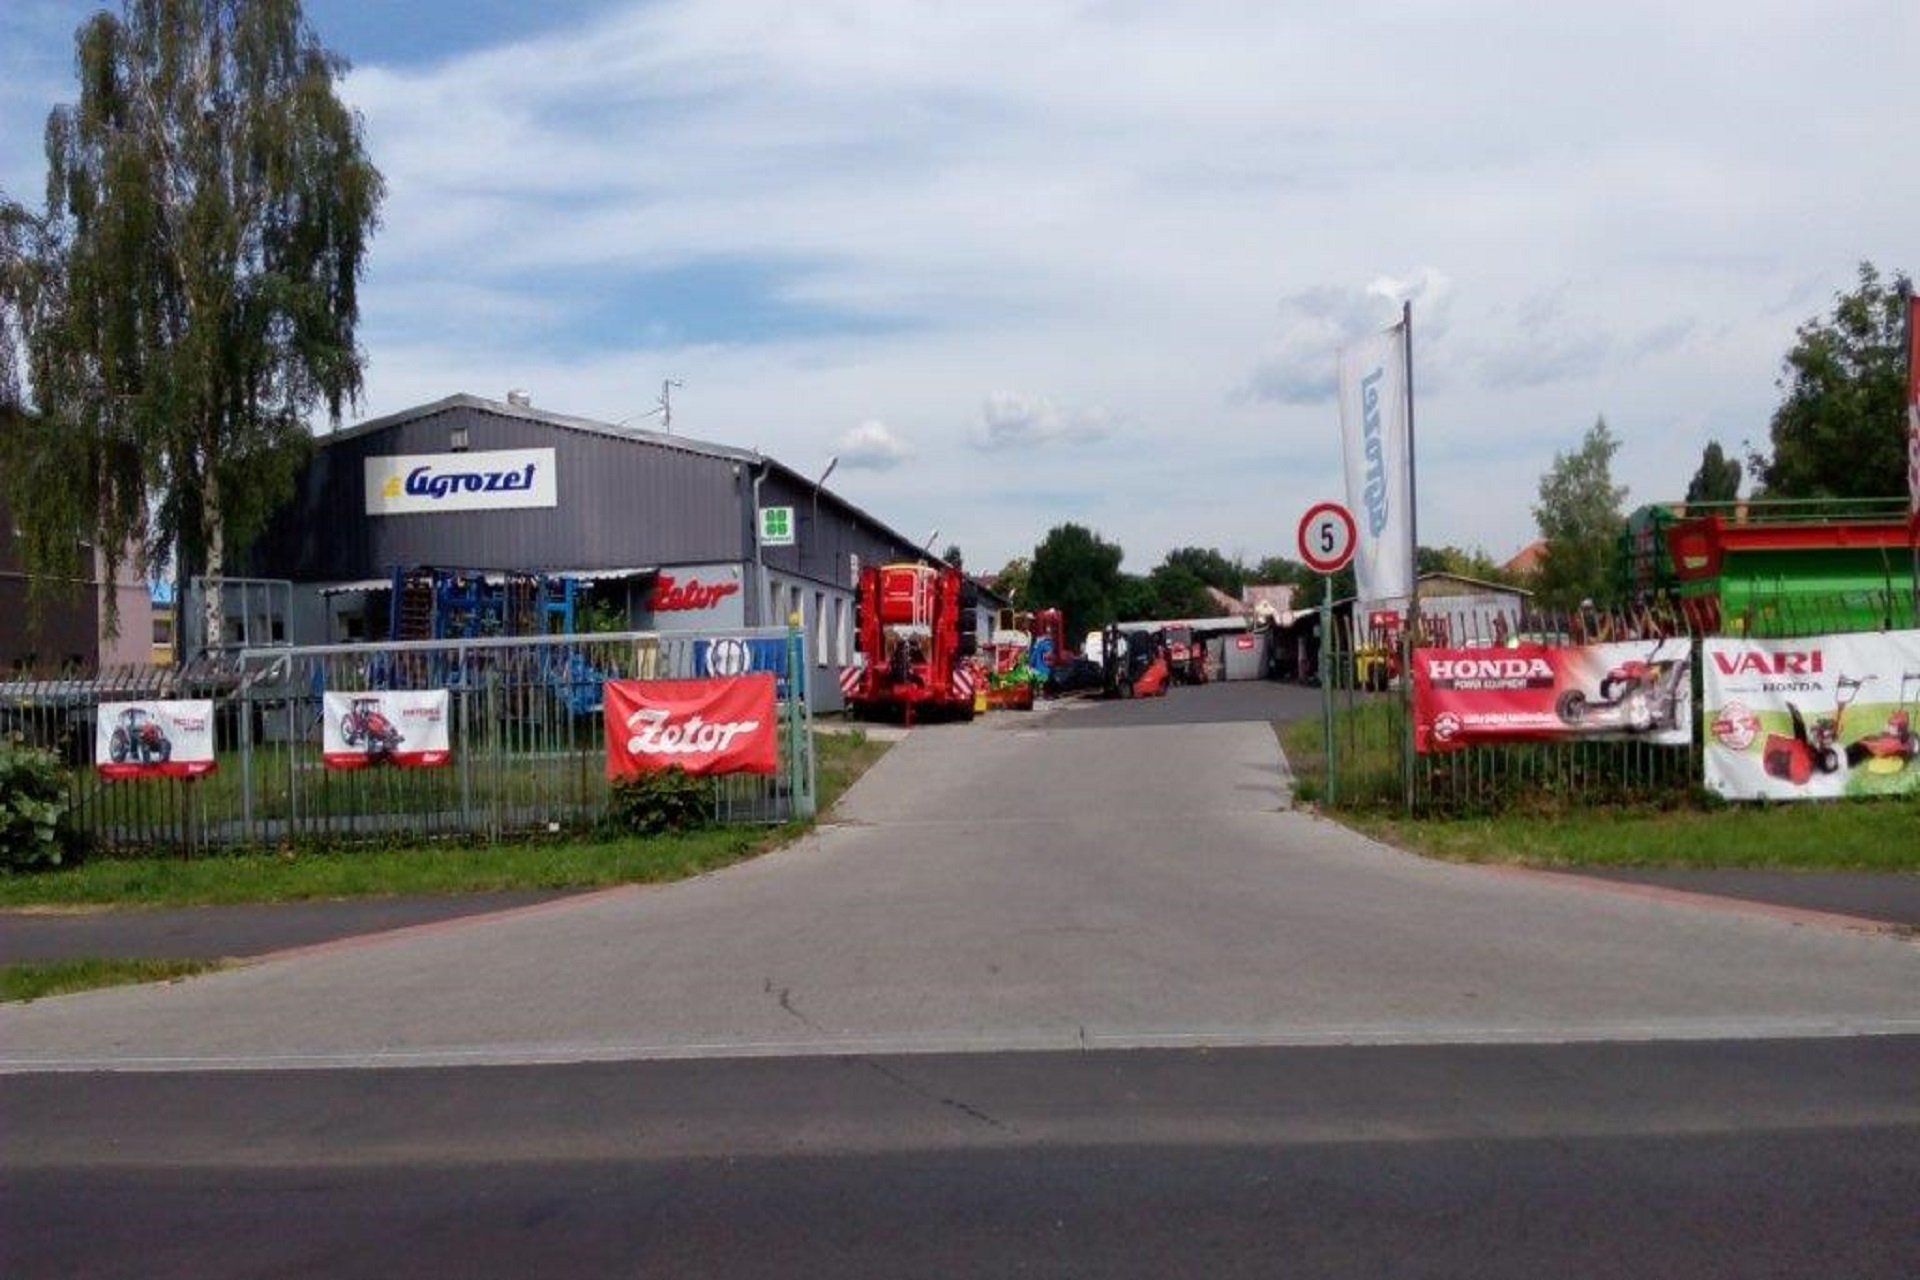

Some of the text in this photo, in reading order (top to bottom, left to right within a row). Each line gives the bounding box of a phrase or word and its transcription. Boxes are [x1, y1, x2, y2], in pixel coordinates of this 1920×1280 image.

[406, 464, 536, 498] Agrozet
[1321, 523, 1335, 552] 5
[647, 576, 739, 611] Zetor
[1428, 659, 1554, 678] HONDA
[1712, 650, 1824, 675] VARI
[1763, 682, 1824, 693] HONDA
[627, 708, 760, 754] Zetor
